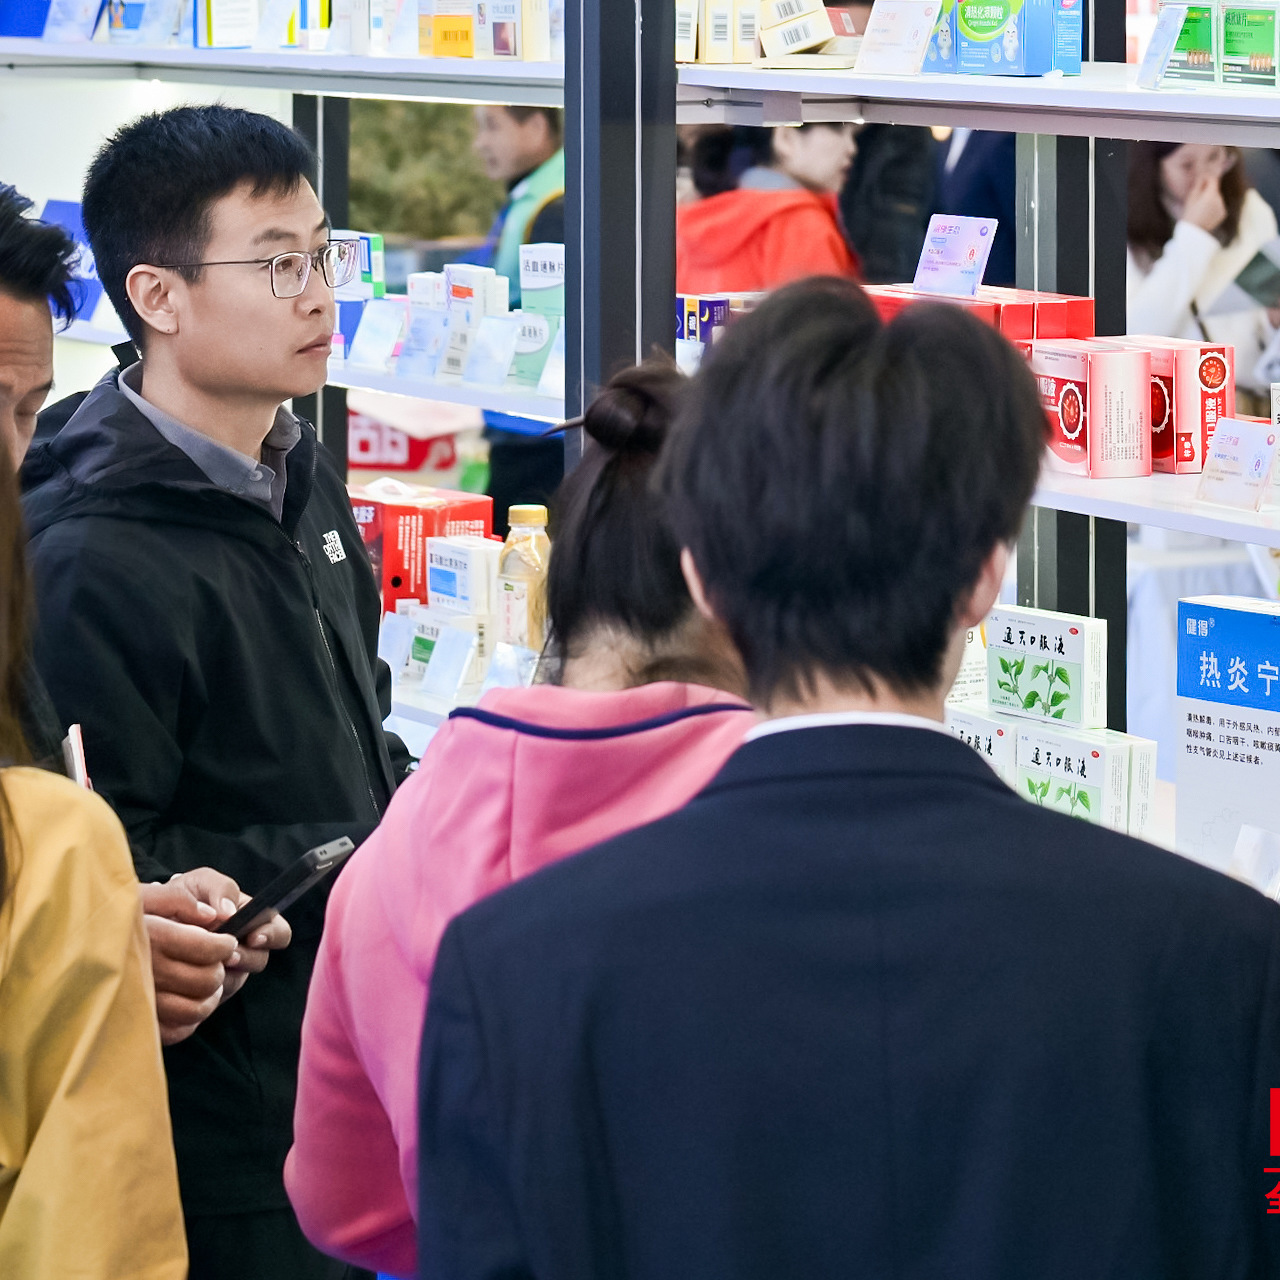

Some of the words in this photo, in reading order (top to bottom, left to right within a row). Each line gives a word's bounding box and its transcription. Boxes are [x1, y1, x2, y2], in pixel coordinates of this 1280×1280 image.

[1002, 626, 1065, 656] 通天口服液
[951, 726, 993, 756] 天口服液
[1031, 747, 1087, 779] 通天口服液
